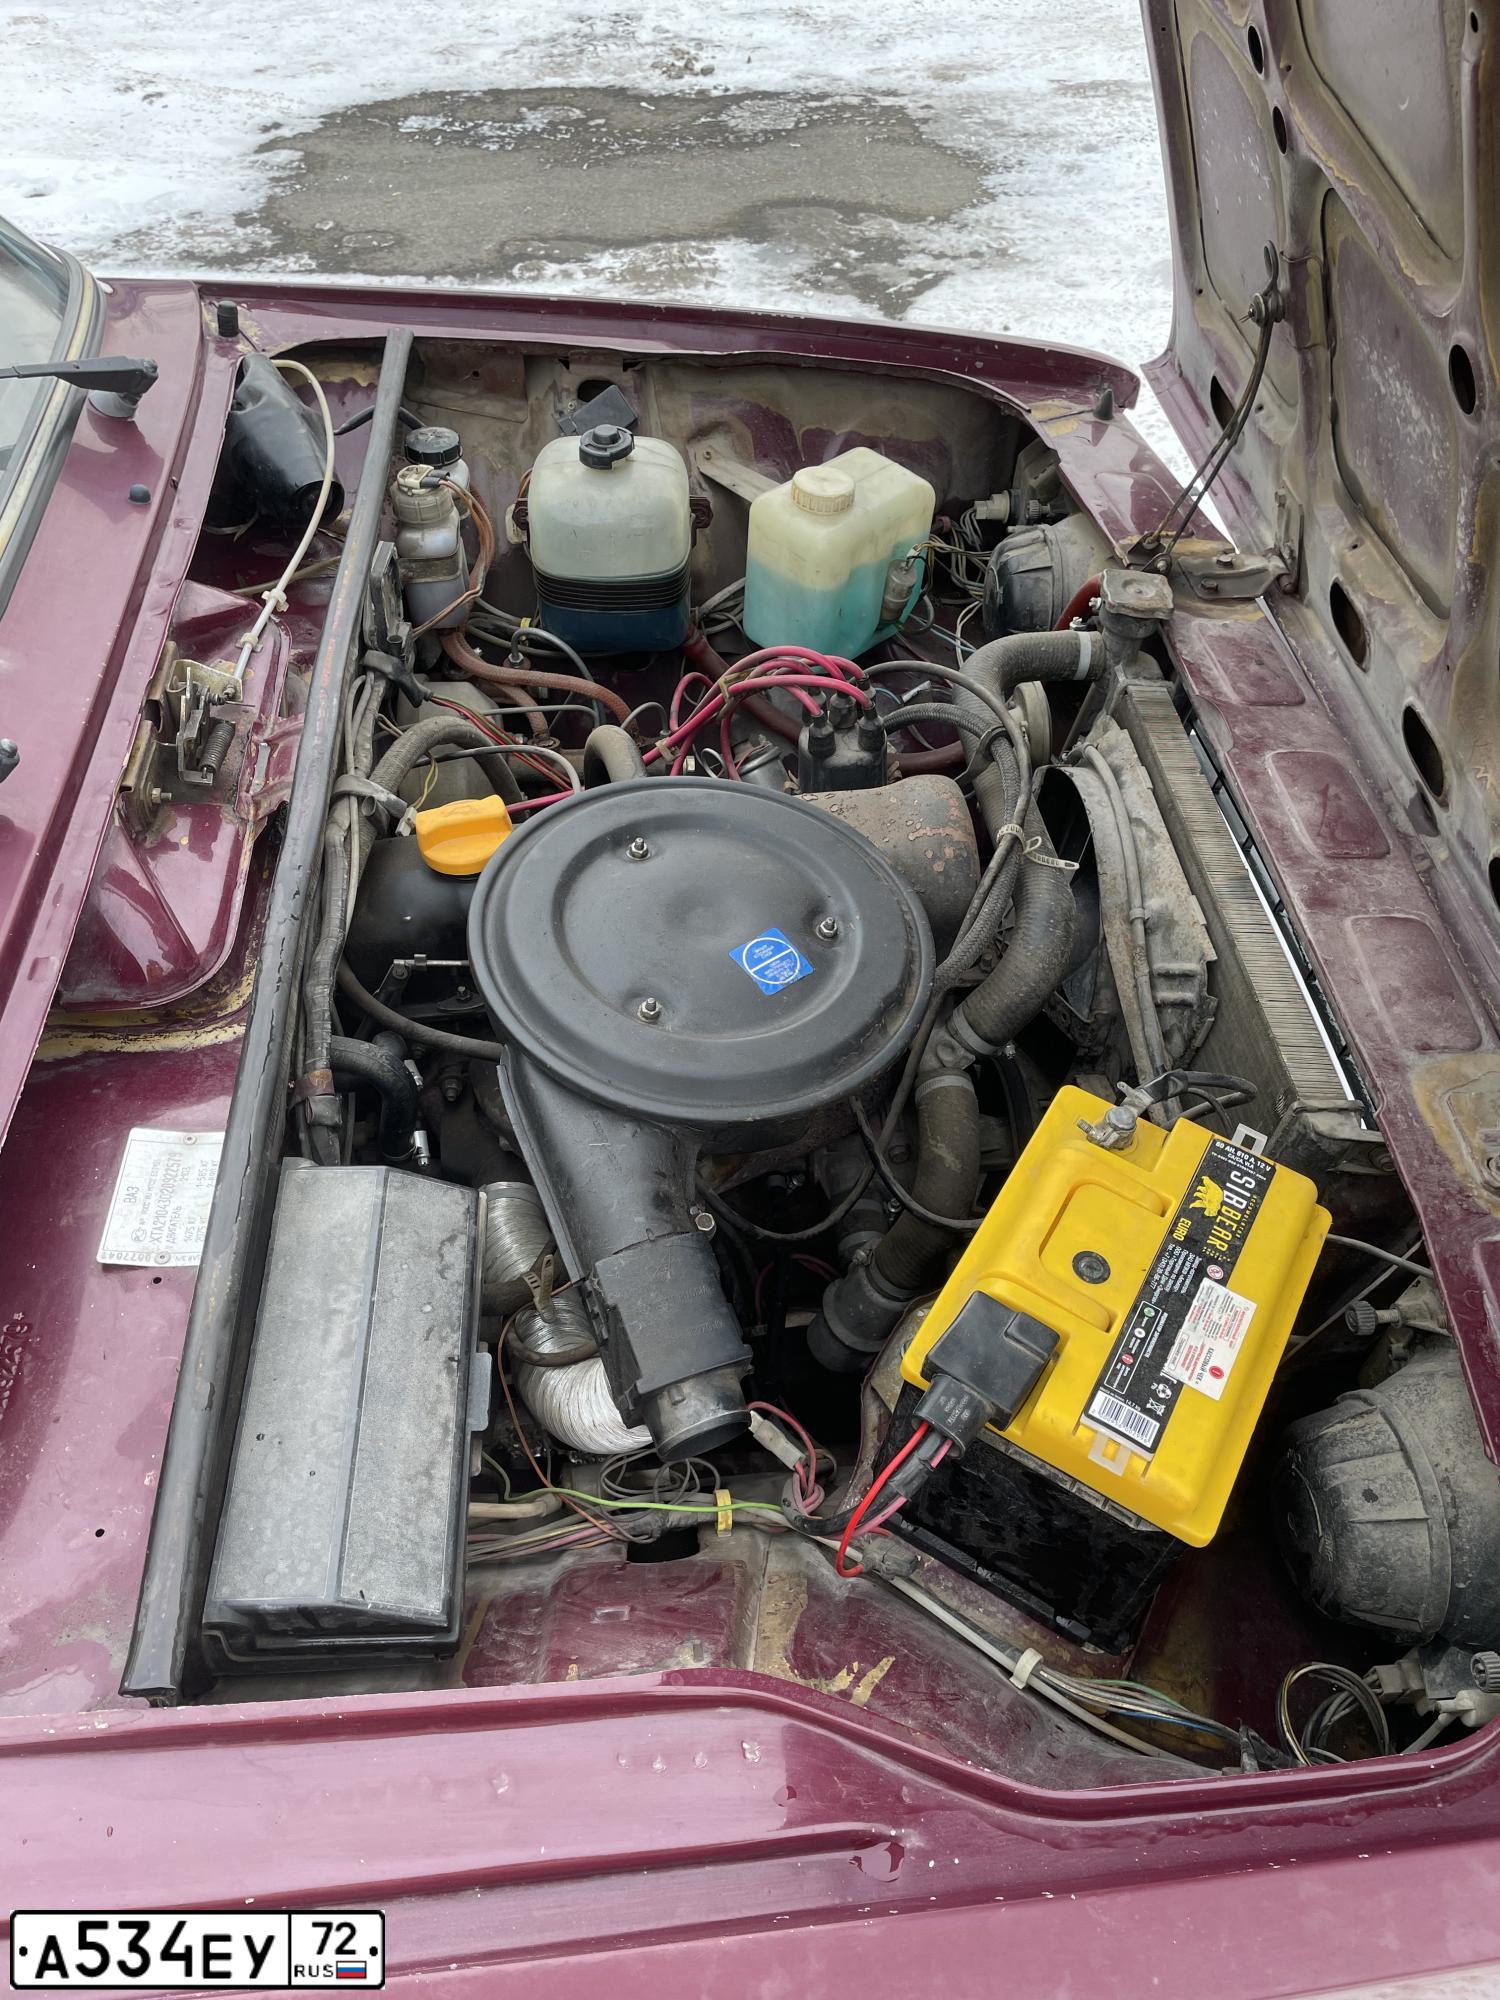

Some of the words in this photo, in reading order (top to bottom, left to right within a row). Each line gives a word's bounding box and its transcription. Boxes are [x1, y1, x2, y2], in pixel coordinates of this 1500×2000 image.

[1235, 1150, 1249, 1160] 610
[123, 1186, 139, 1203] ВАЗ
[1173, 1217, 1191, 1241] EURO
